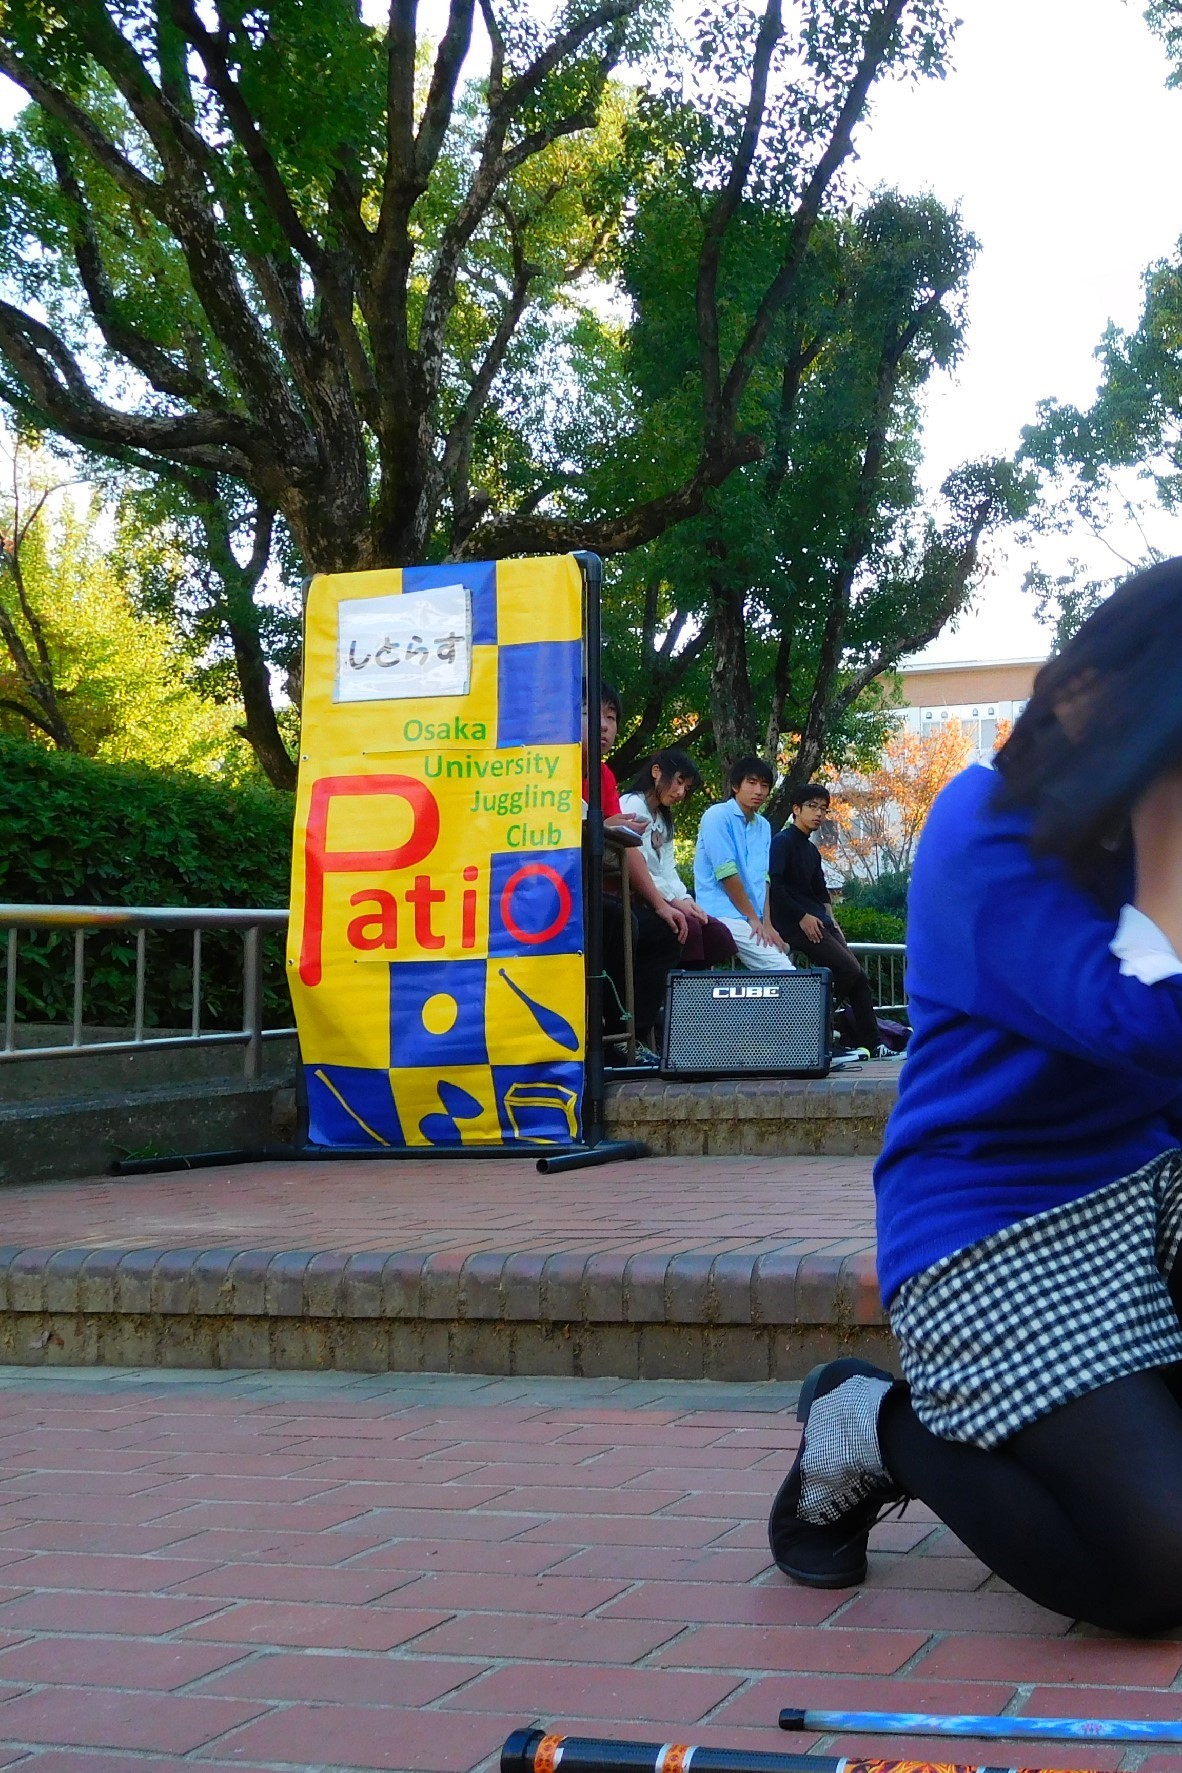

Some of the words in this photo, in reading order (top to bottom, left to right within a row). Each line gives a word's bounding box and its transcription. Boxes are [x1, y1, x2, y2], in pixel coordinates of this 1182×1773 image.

[348, 631, 466, 671] しとらす
[403, 716, 487, 742] Osaka
[424, 751, 560, 779] University
[470, 784, 573, 816] Juggling
[506, 822, 562, 847] Club
[712, 986, 780, 999] CUBE
